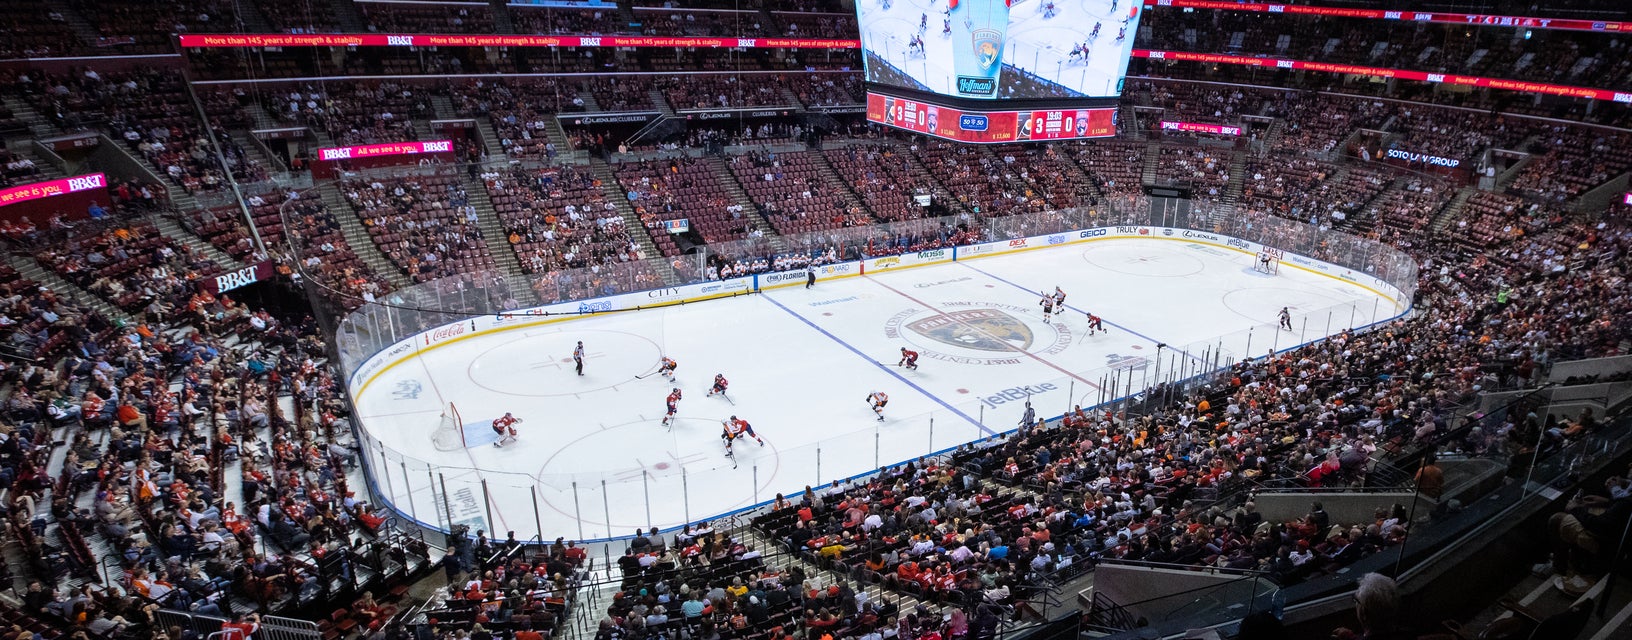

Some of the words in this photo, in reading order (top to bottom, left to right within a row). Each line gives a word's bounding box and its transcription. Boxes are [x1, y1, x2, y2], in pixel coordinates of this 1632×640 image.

[204, 36, 226, 44] More
[263, 38, 283, 46] years
[294, 37, 324, 46] strength
[334, 36, 362, 45] stability
[387, 36, 414, 46] BB&T
[502, 37, 528, 45] strength
[536, 37, 560, 45] stability
[580, 37, 601, 46] BB&T
[1427, 74, 1446, 82] BB&T
[1547, 86, 1569, 96] strength
[1576, 89, 1596, 98] stability
[897, 106, 902, 120] 3
[919, 110, 924, 126] 0
[1047, 112, 1062, 120] 19:03
[1036, 118, 1043, 134] 3
[1066, 117, 1072, 132] 0
[422, 141, 450, 152] BB&T
[323, 148, 352, 160] BB&T
[1388, 149, 1409, 159] SOTO
[1430, 156, 1460, 167] GROUP
[68, 174, 102, 192] BB&T
[1, 193, 14, 202] we
[14, 190, 30, 198] see
[1080, 229, 1106, 238] GEICO
[1227, 238, 1250, 249] jetBlue
[214, 266, 258, 293] BB&T
[782, 272, 806, 280] FLORIDA
[648, 288, 680, 298] CITY
[919, 310, 994, 330] PANTHERS
[976, 382, 1058, 410] jetBlue
[453, 488, 480, 516] Health
